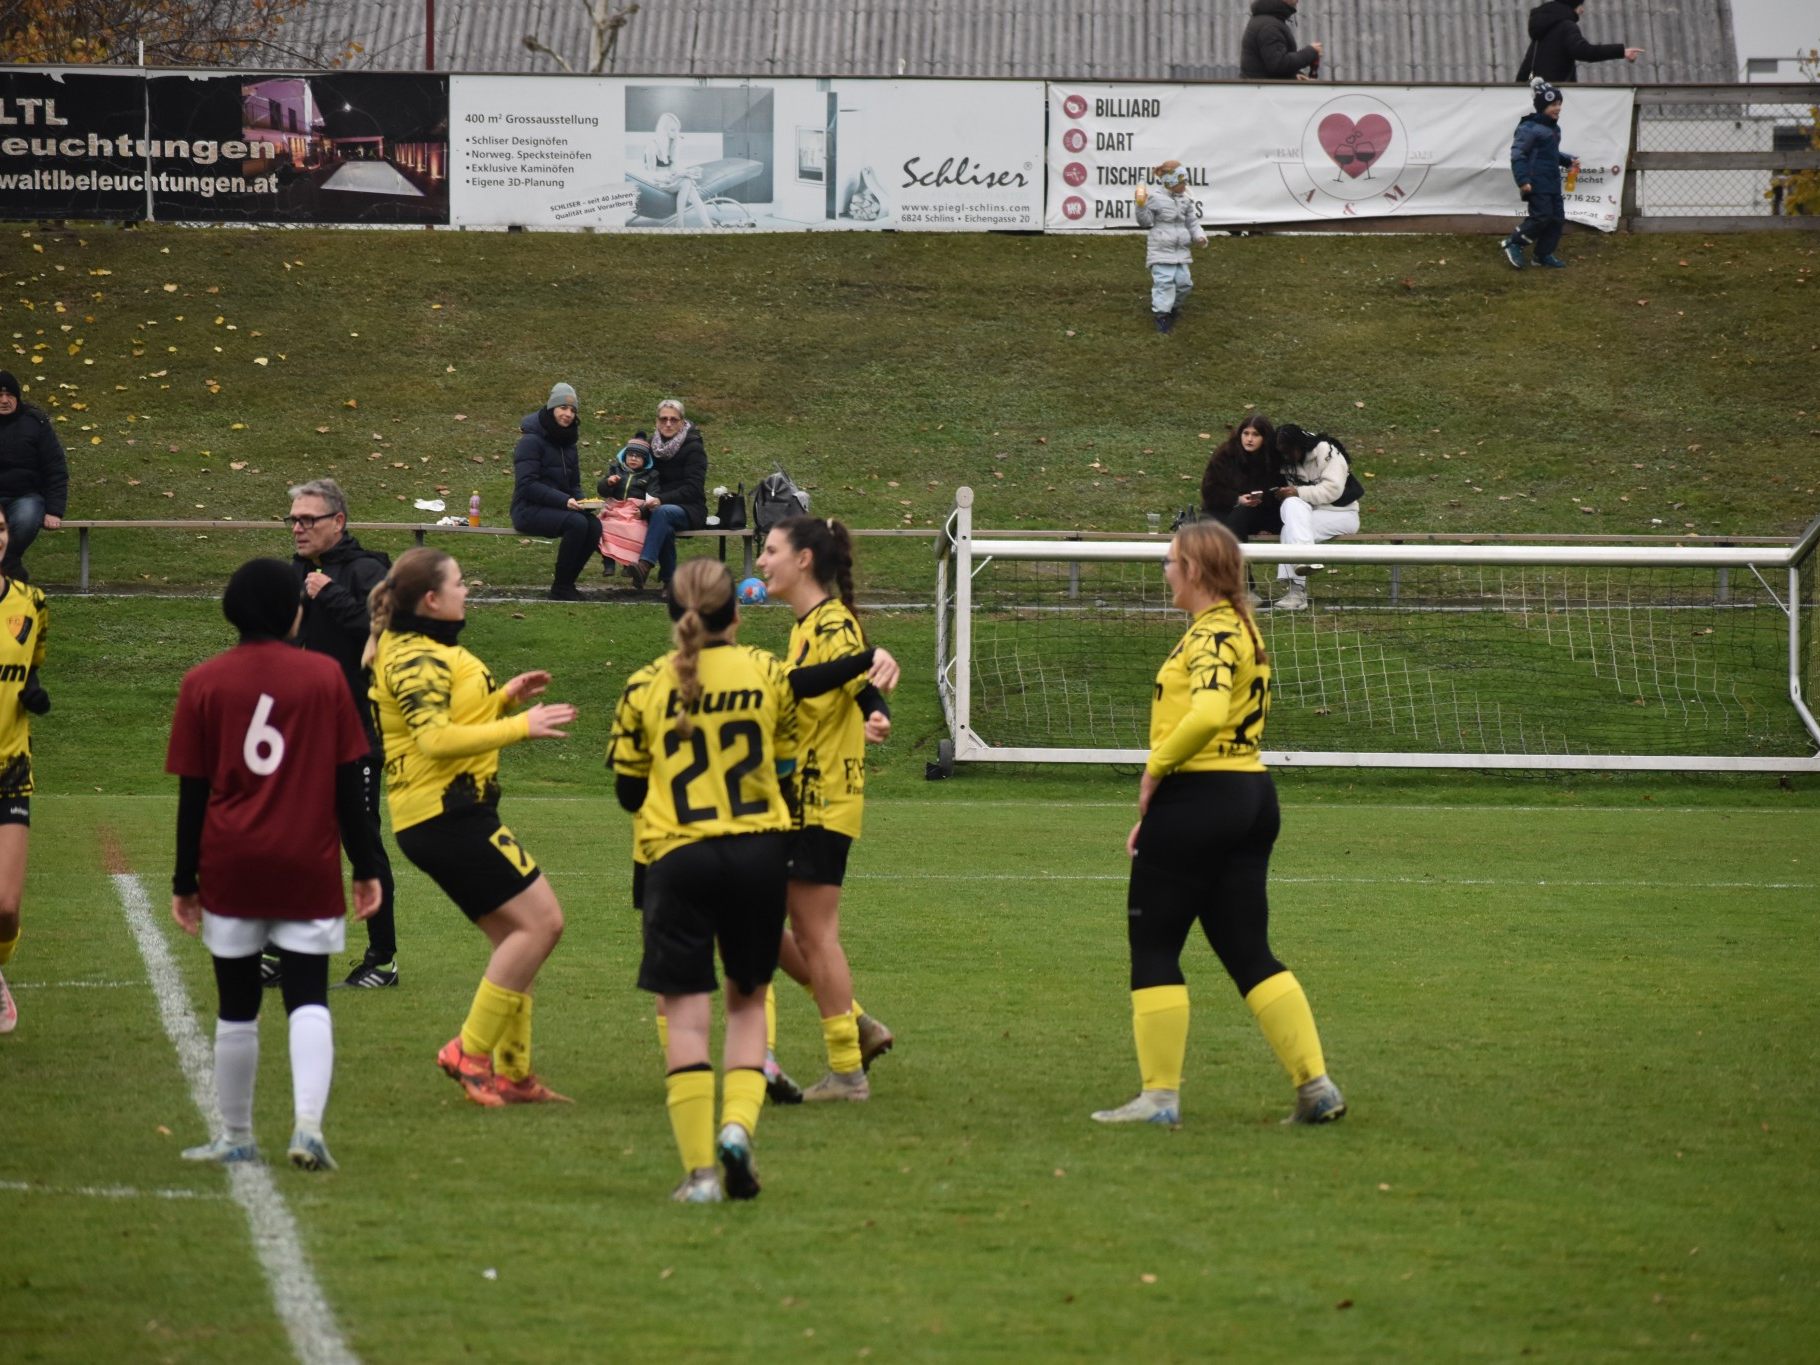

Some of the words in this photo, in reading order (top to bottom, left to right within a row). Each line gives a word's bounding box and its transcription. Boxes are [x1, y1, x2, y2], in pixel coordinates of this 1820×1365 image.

[1095, 98, 1161, 118] BILLIARD
[465, 114, 485, 123] 400
[505, 114, 599, 127] Grossausstellung
[471, 136, 508, 145] Schliser
[512, 136, 568, 147] Designöfen
[1096, 132, 1134, 151] DART
[1, 133, 275, 164] euchtungen
[471, 150, 514, 160] Norweg.
[517, 150, 592, 161] Specksteinöfen
[471, 164, 518, 173] Exklusive
[520, 164, 575, 174] Kaminöfen
[902, 156, 1029, 189] Schliser
[0, 169, 279, 198] waltlbeleuchtungen.at
[471, 178, 505, 188] Eigene
[508, 178, 565, 189] 3D-Planung
[550, 201, 581, 212] SCHLISER
[901, 203, 1030, 214] www.spiegl-schlins.com
[901, 214, 922, 223] 6824
[925, 214, 954, 223] Schlins
[964, 214, 1017, 225] Eichengasse
[1019, 215, 1030, 223] 20
[243, 692, 285, 776] 6
[664, 719, 770, 826] 22
